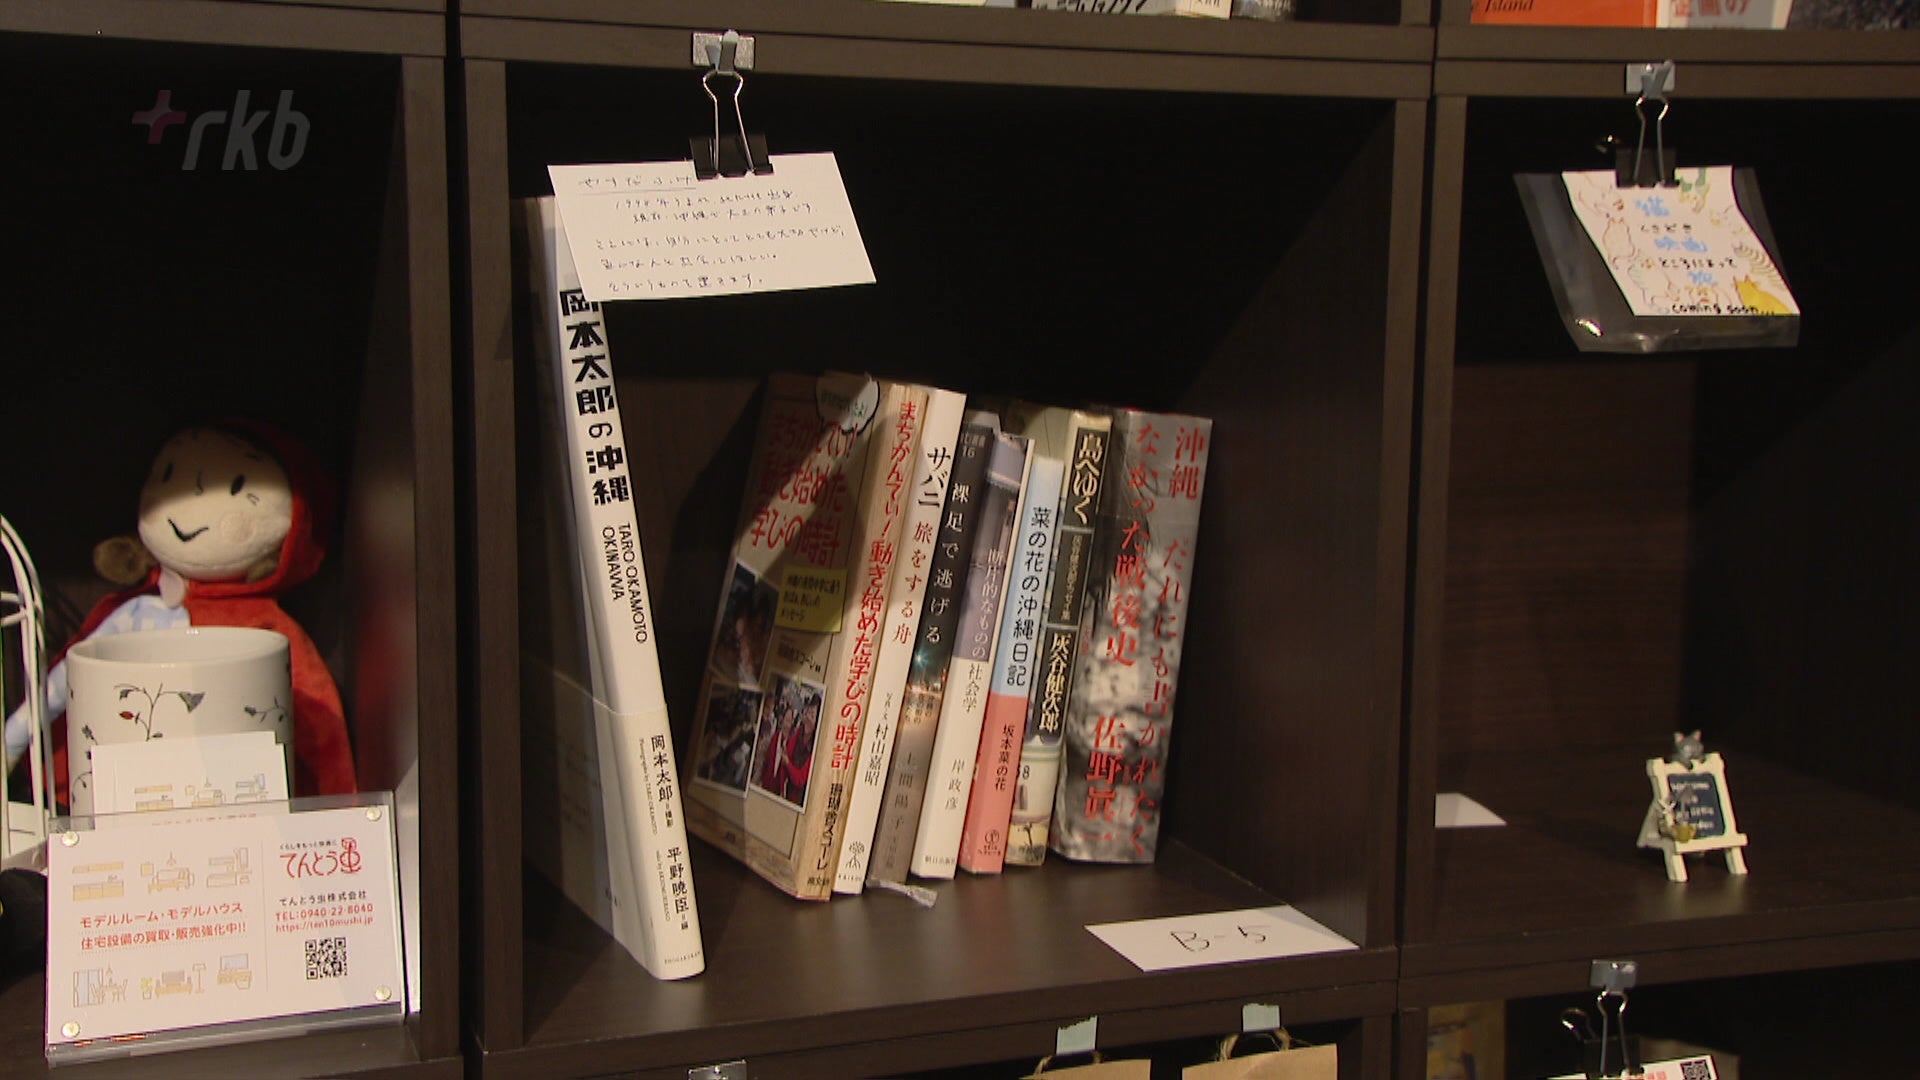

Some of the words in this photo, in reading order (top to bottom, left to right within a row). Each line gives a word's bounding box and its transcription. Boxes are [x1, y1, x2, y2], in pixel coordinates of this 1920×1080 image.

[918, 446, 951, 508] サバニ
[602, 526, 625, 601] OKINAWA
[618, 522, 635, 562] TARO
[625, 565, 648, 643] OKAMOTO
[1007, 506, 1052, 687] 菜の花の沖縄日記
